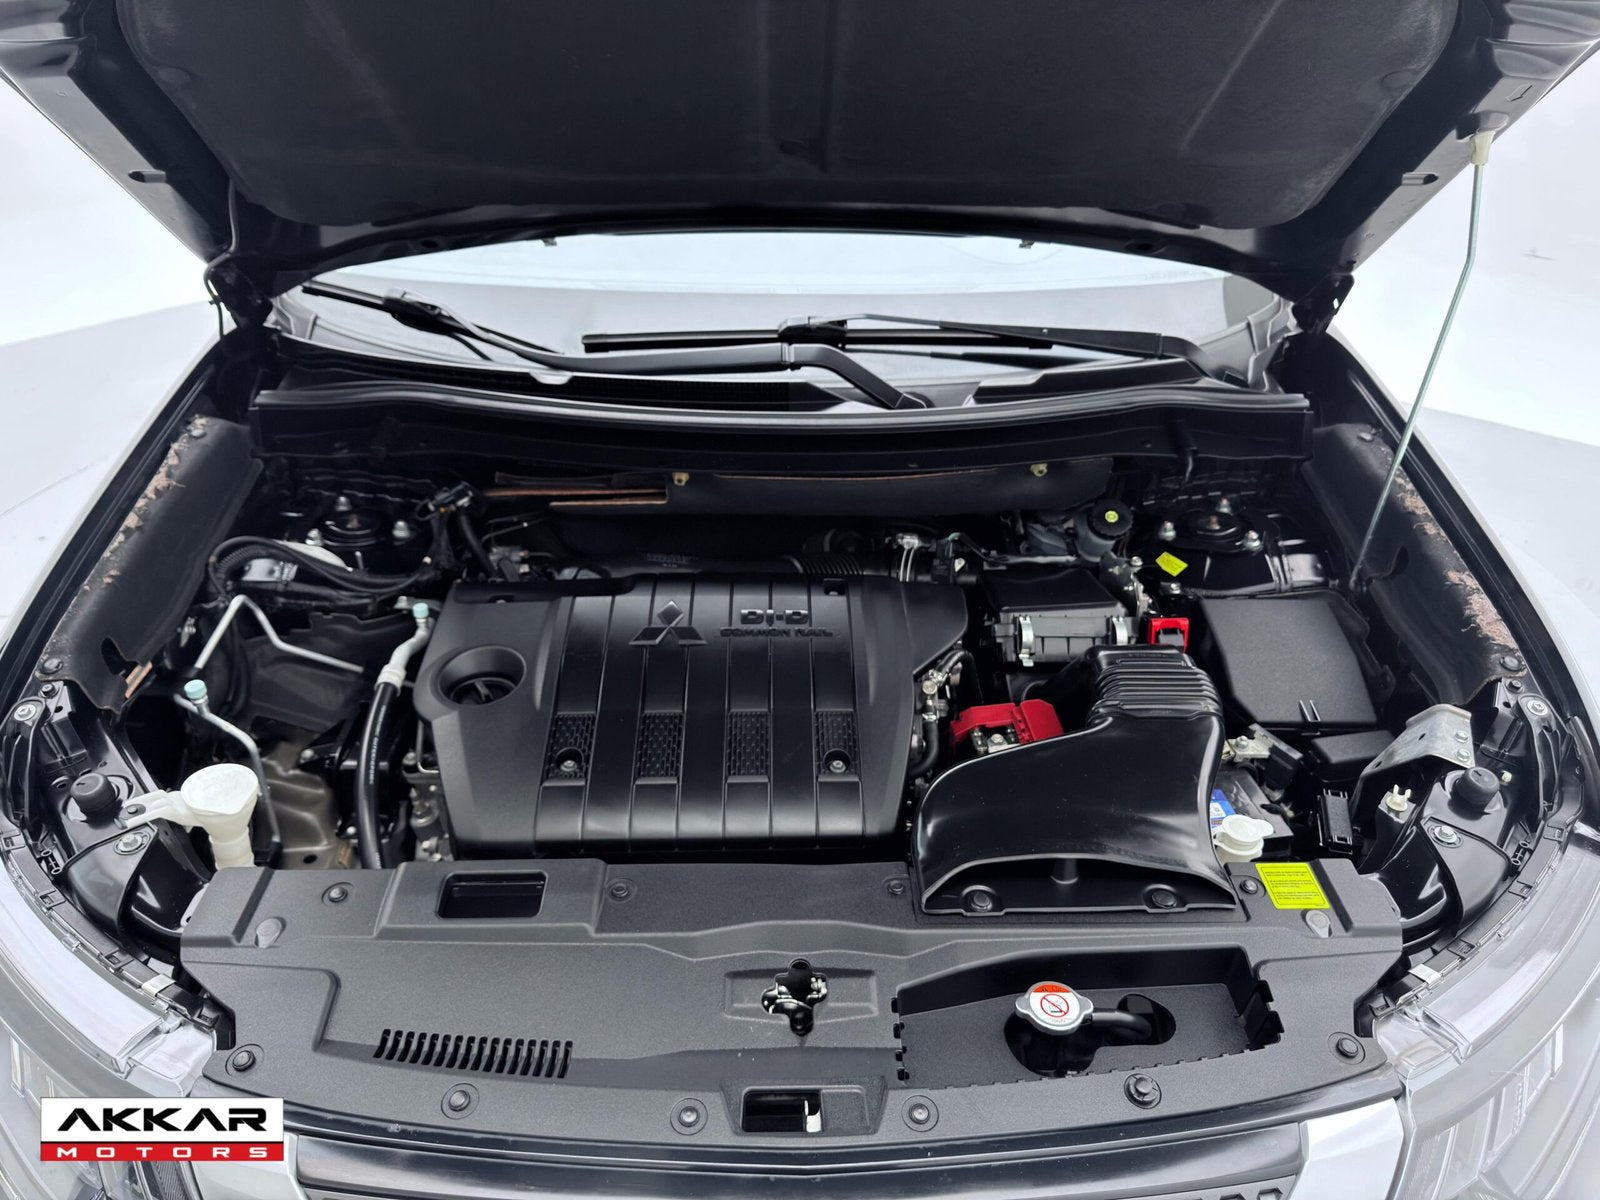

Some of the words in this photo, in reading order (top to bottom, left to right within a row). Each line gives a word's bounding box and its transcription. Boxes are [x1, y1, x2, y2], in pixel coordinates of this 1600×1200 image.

[740, 608, 809, 625] DI-D
[720, 627, 791, 638] COMMON
[794, 627, 833, 638] RAIL
